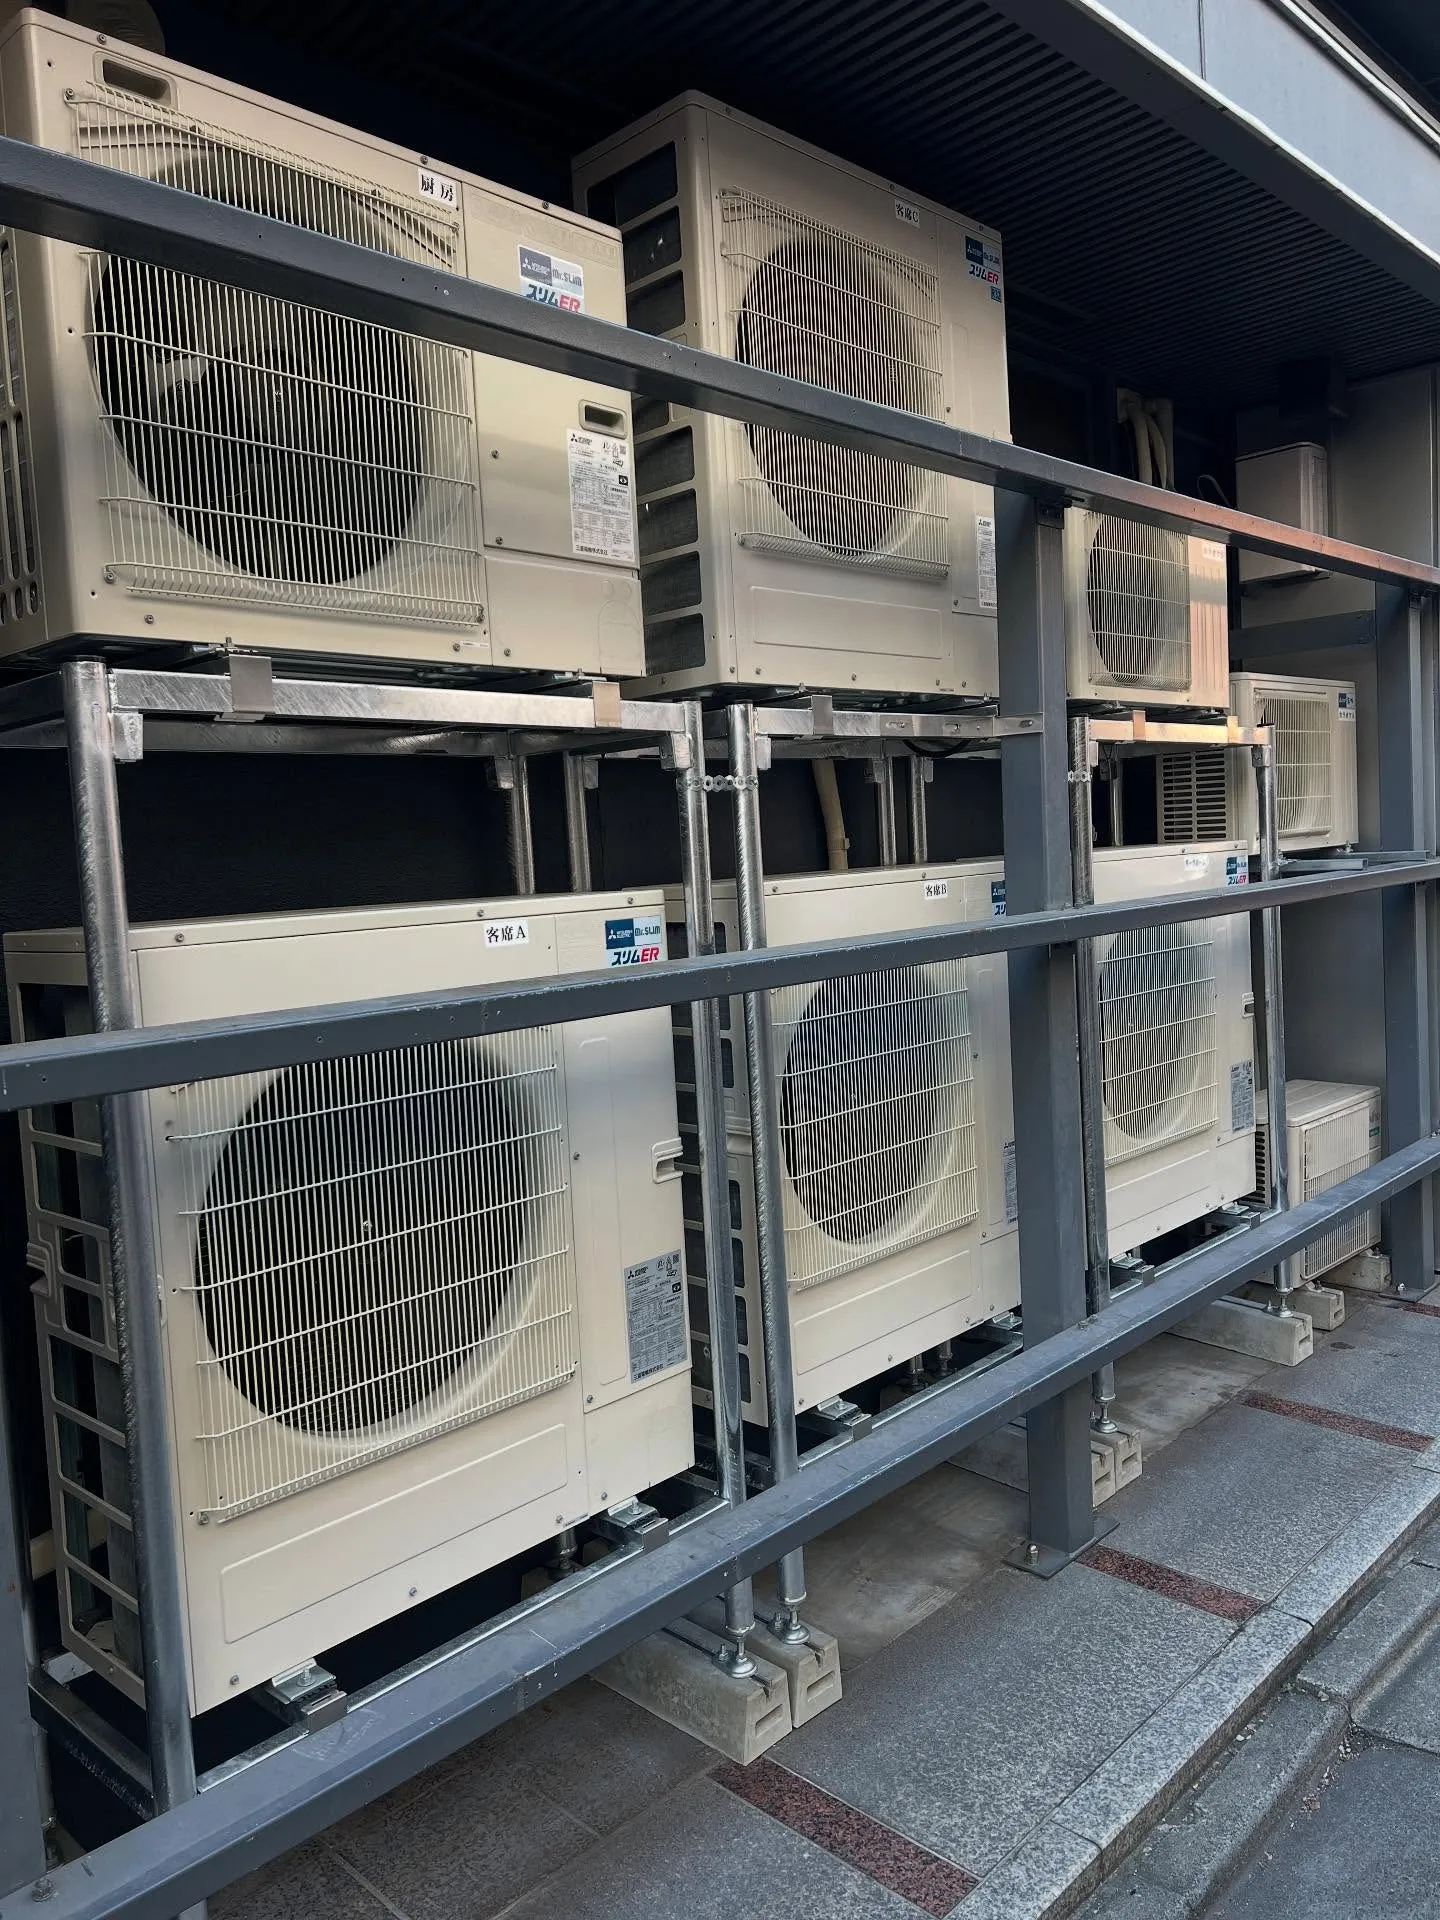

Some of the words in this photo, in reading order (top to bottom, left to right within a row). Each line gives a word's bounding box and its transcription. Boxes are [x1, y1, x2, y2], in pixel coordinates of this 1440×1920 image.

[421, 174, 453, 201] 厨房
[896, 204, 918, 222] 客席C
[969, 264, 999, 284] スリムER
[526, 284, 581, 312] スリムER
[926, 884, 947, 897] 客席B
[486, 925, 526, 943] 客席A
[635, 926, 660, 936] Mr.SLIM
[612, 947, 659, 966] スリムER
